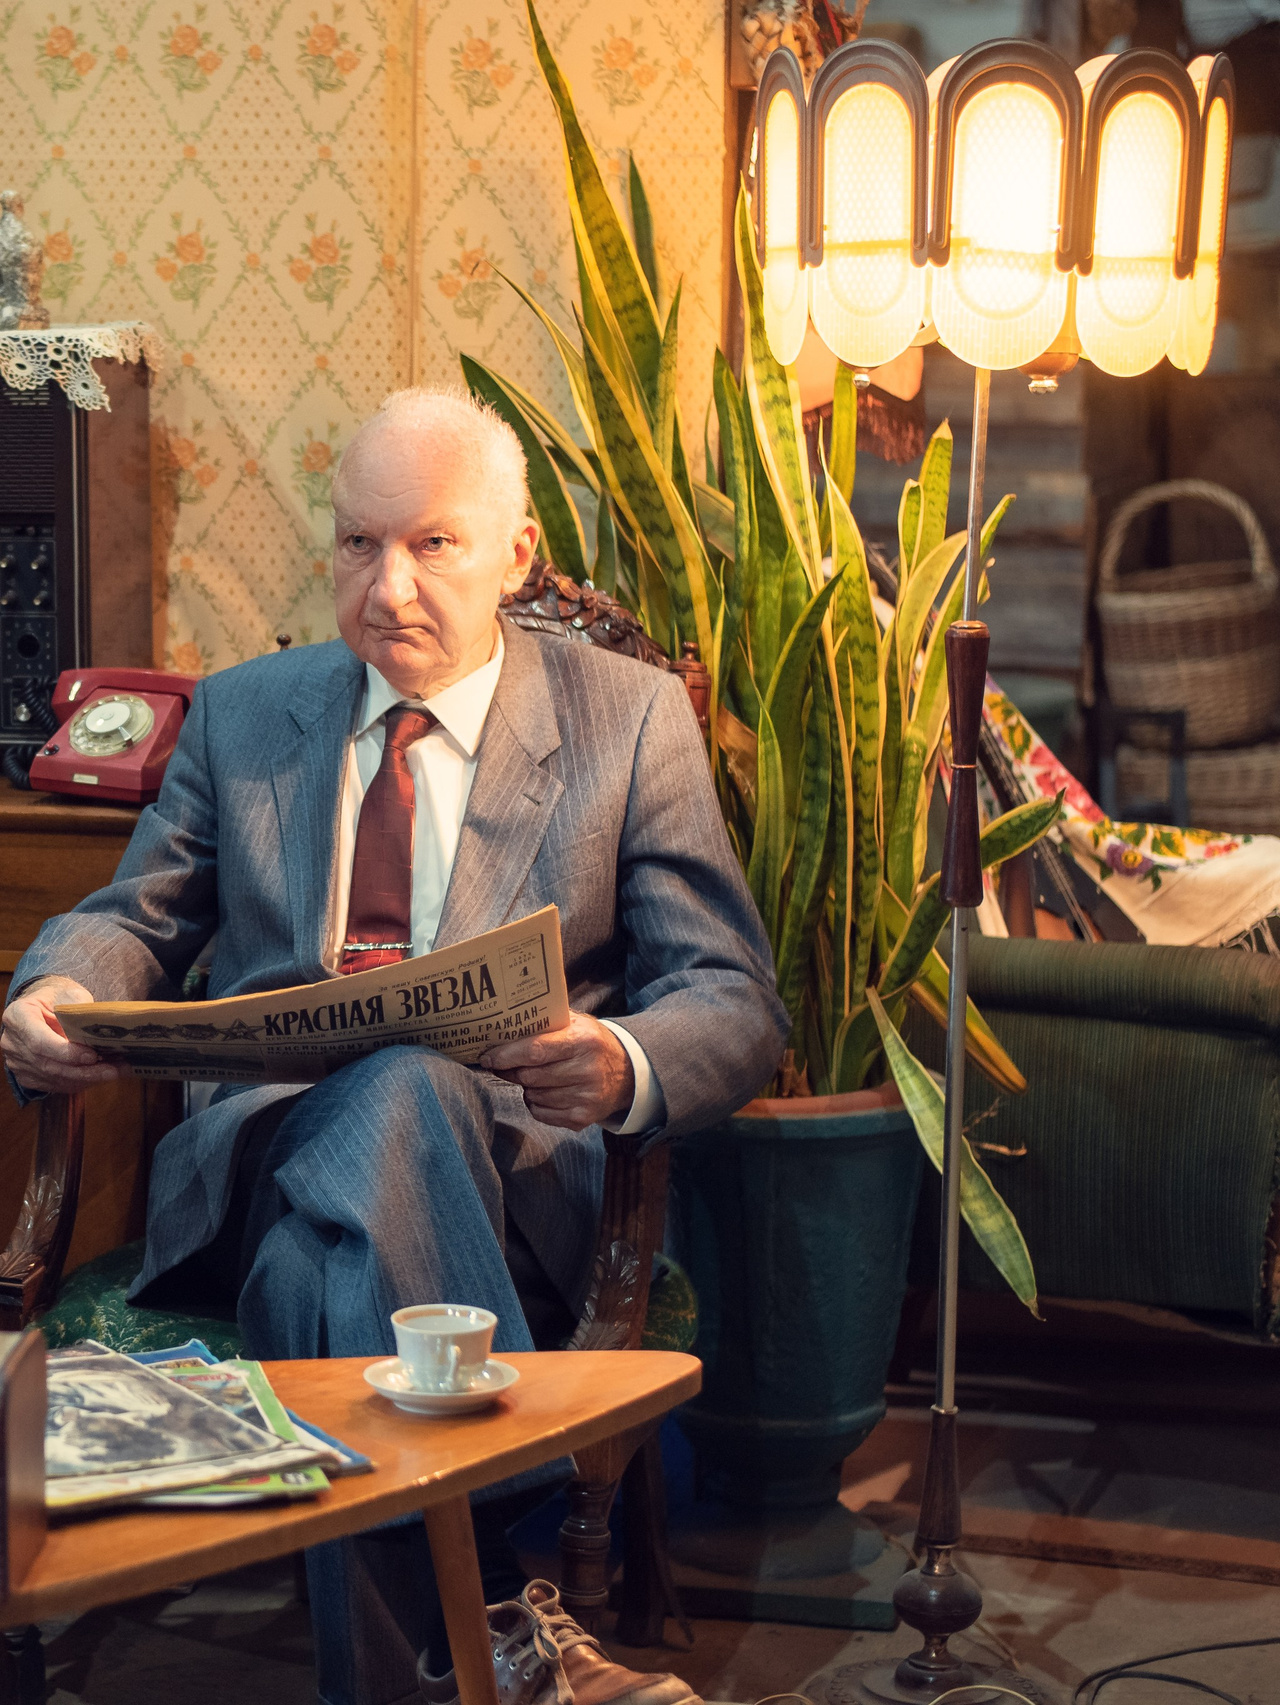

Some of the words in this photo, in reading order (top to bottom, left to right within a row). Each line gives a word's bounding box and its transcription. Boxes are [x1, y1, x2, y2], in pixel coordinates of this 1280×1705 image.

[519, 966, 529, 977] 4
[264, 994, 385, 1036] КРАСНАЯ
[395, 963, 498, 1021] ЗВЕЗДА
[435, 1010, 473, 1022] ОБОРОНЫ
[479, 1001, 498, 1012] СССР
[373, 1027, 470, 1048] ОБЕСПЕЧЕНИЮ
[427, 1033, 491, 1051] ЦИАЛЬНЫЕ
[498, 1016, 551, 1041] ГАРАНТИИ
